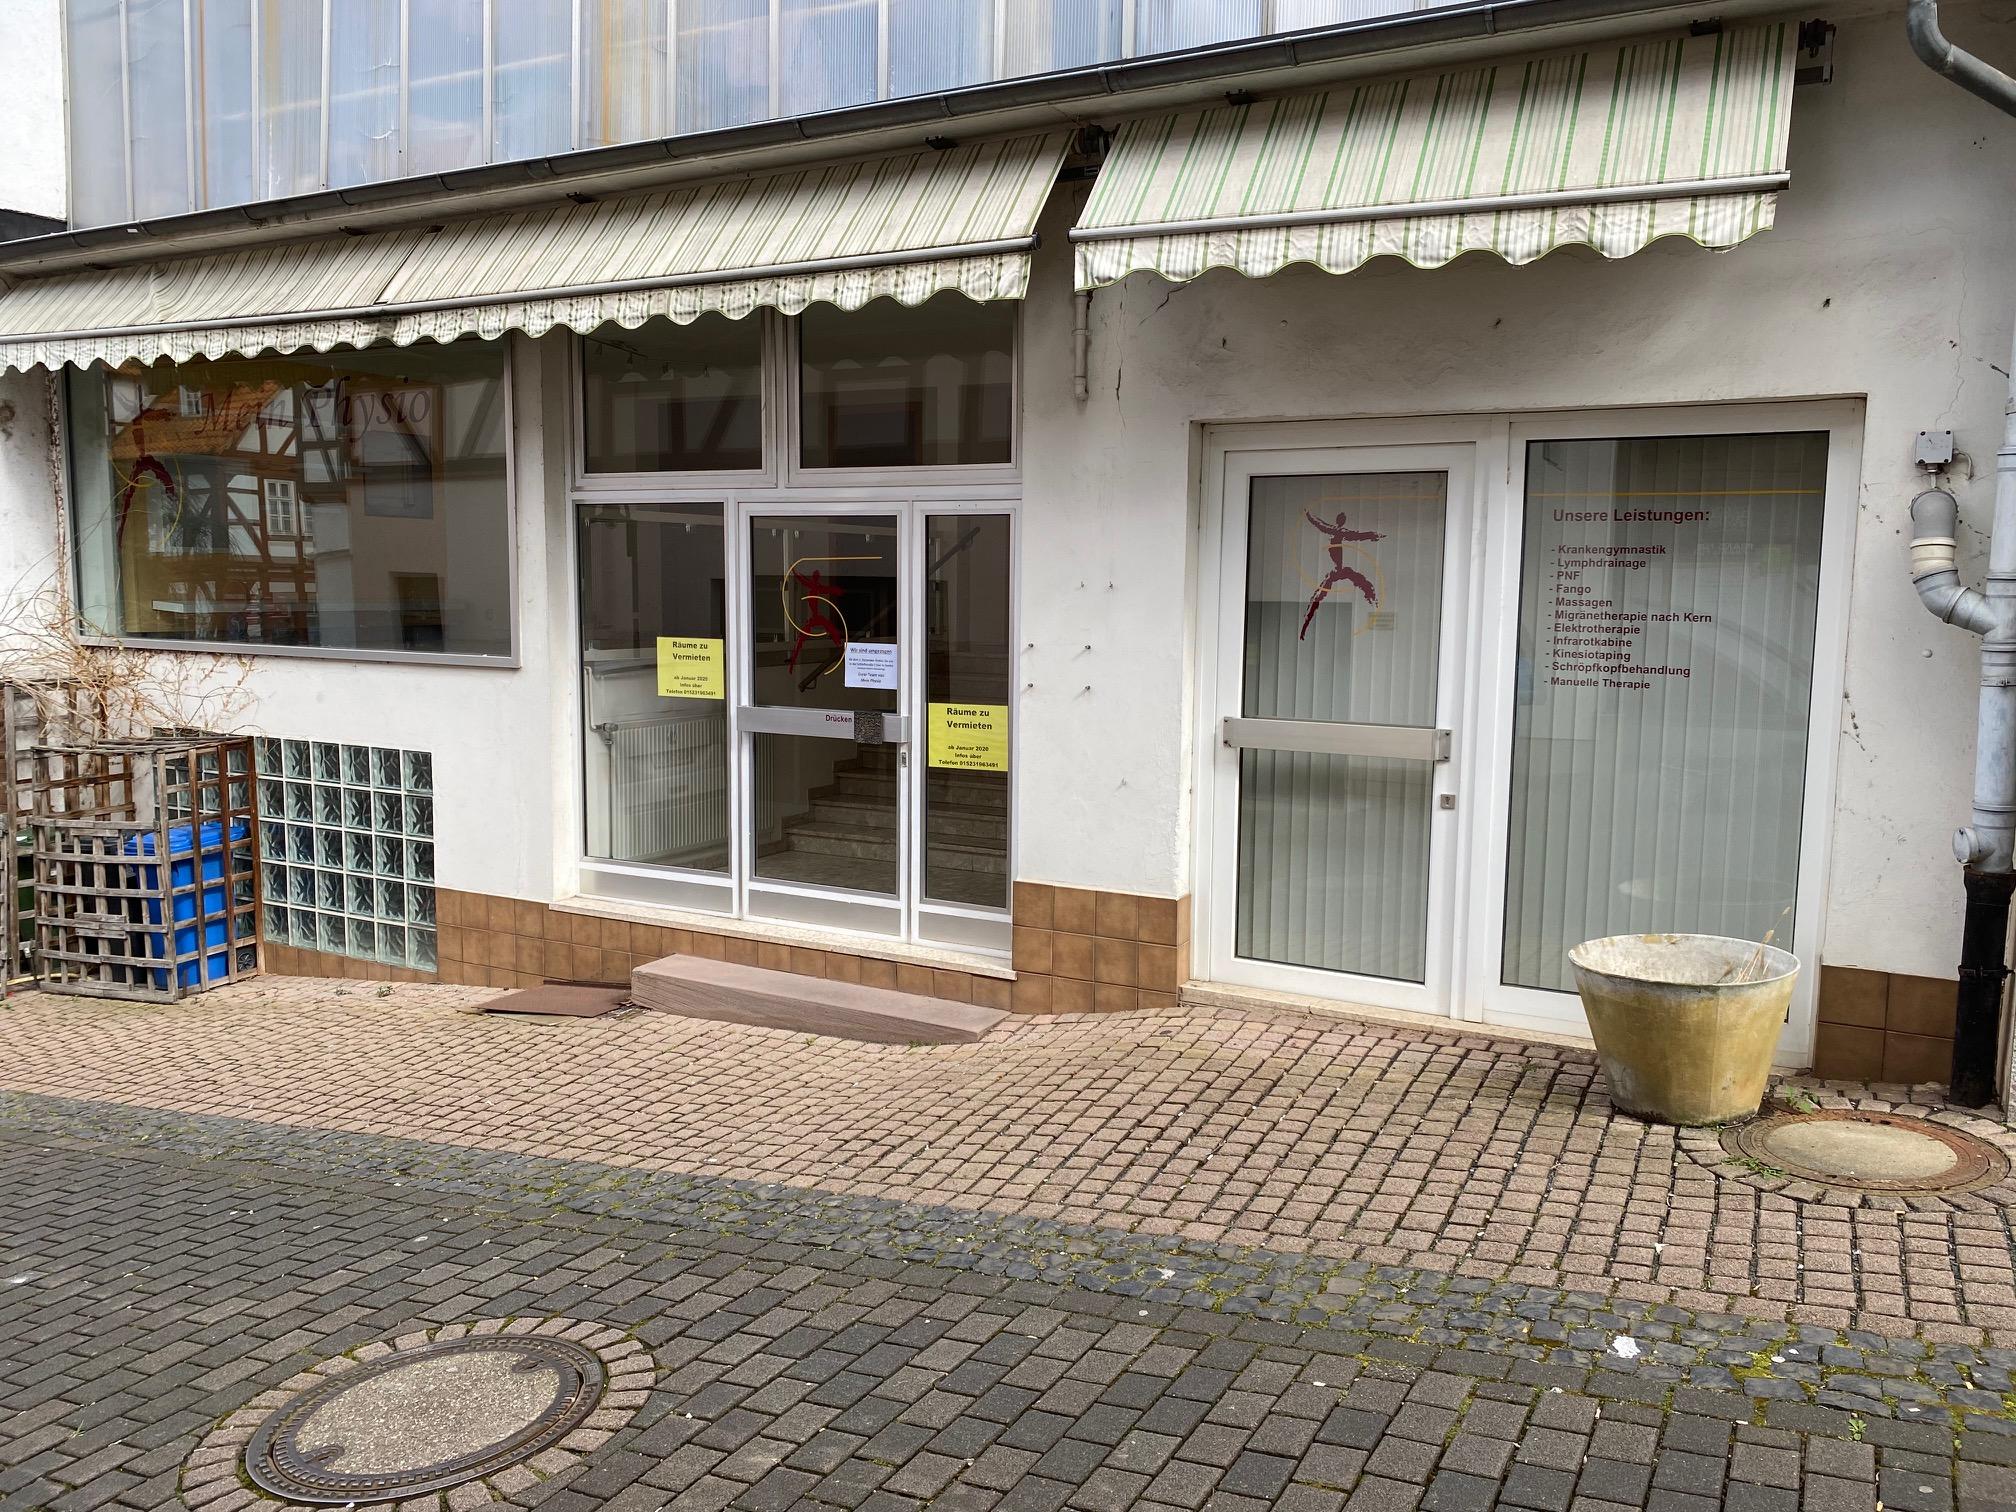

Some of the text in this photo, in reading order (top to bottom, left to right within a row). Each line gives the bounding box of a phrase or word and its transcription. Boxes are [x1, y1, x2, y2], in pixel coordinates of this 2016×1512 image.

[194, 375, 431, 443] Mein Physio
[1553, 509, 1709, 524] Unsere Leistungen:
[1558, 545, 1666, 556] Krankengymnastik
[1558, 558, 1646, 570] Lymphdrainage
[1557, 571, 1580, 580] PNF
[1556, 584, 1591, 595] Fango
[1555, 597, 1612, 609] Massagen
[1555, 610, 1648, 622] Migränetherapie
[1651, 612, 1679, 622] nach
[1683, 612, 1712, 622] Kern
[1554, 623, 1640, 635] Elektrotherapie
[672, 641, 697, 649] Räume
[1553, 636, 1632, 647] Infrarotkabine
[673, 653, 710, 661] Vermieten
[1552, 649, 1631, 662] Kinesiotaping
[1552, 662, 1691, 678] Schröpfkopfbehandlung
[1551, 677, 1599, 687] Manuelle
[1602, 678, 1650, 690] Therapie
[947, 708, 977, 716] Räume
[826, 714, 853, 722] Drücken
[947, 720, 992, 729] Vermieten
